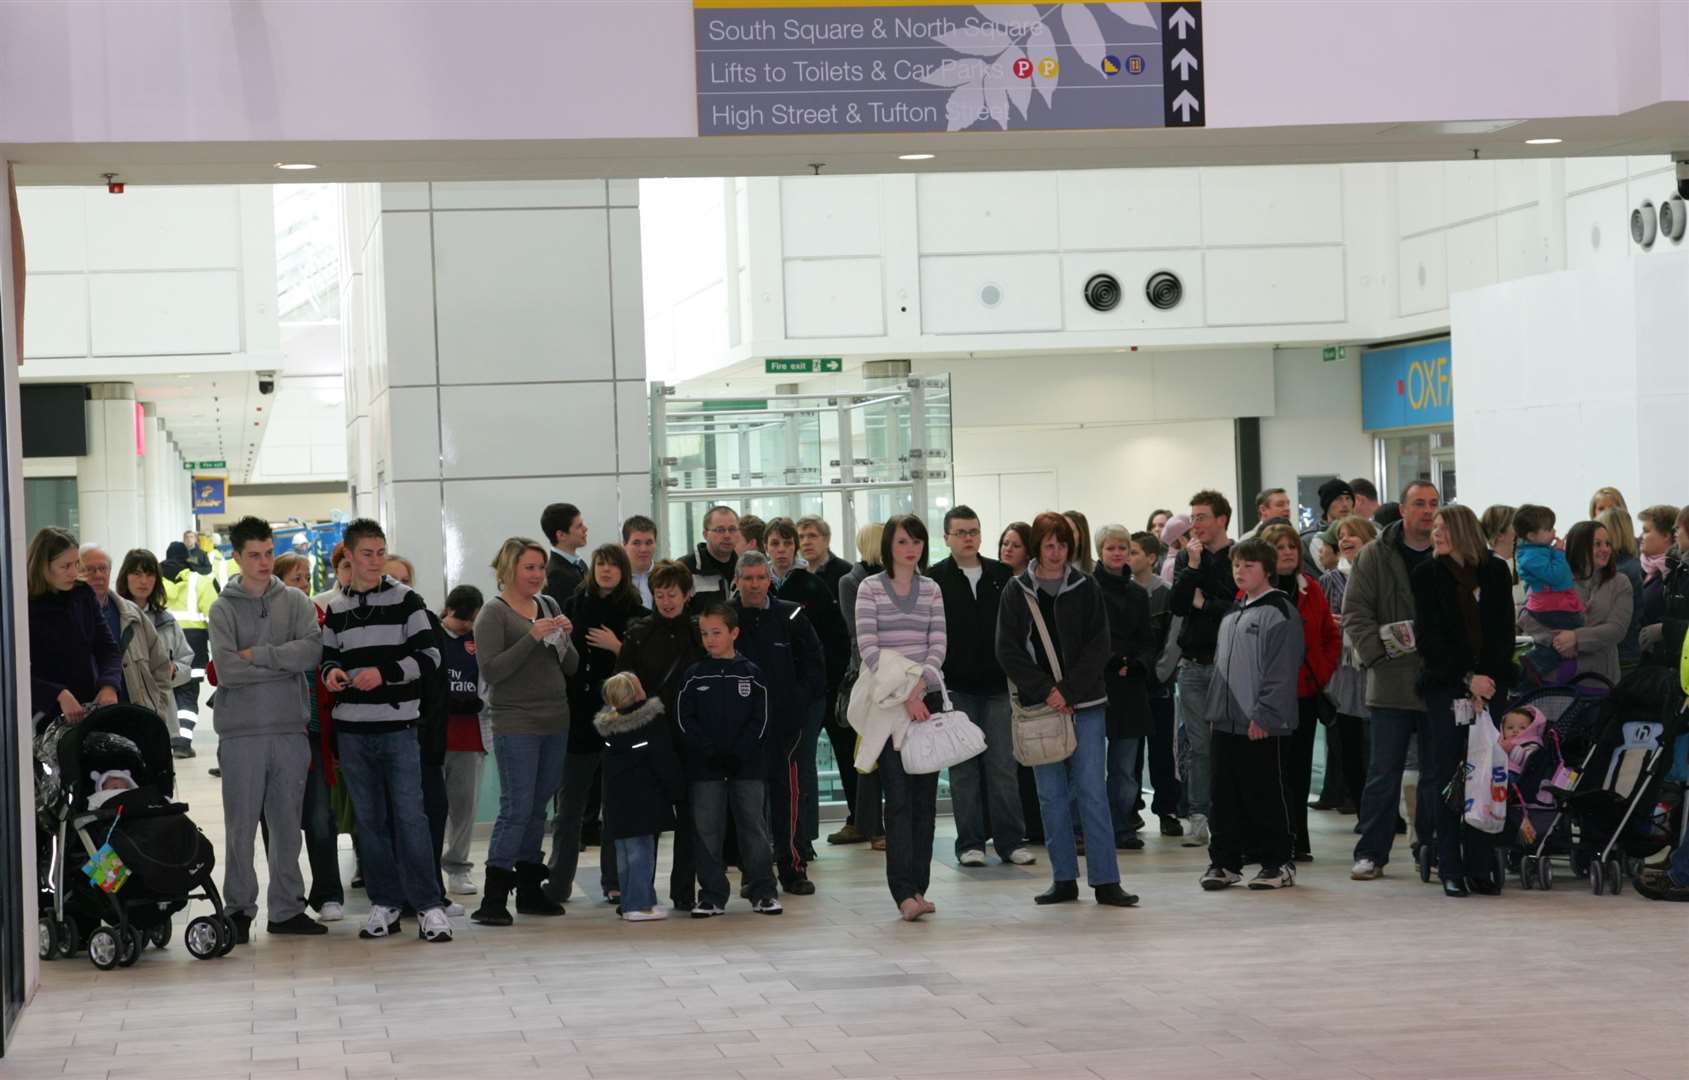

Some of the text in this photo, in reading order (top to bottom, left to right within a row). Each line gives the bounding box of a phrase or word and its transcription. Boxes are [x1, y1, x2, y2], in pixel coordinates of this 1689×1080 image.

[709, 16, 1042, 44] South Square & North Square
[711, 62, 757, 83] Lifts
[763, 63, 786, 82] to
[792, 61, 864, 82] Toilets
[871, 60, 887, 81] &
[894, 59, 934, 81] Car
[942, 59, 1004, 80] Parks
[712, 104, 763, 130] High
[772, 103, 838, 125] Street
[846, 102, 862, 123] &
[868, 101, 937, 123] Tufton
[771, 362, 806, 370] Fire exit
